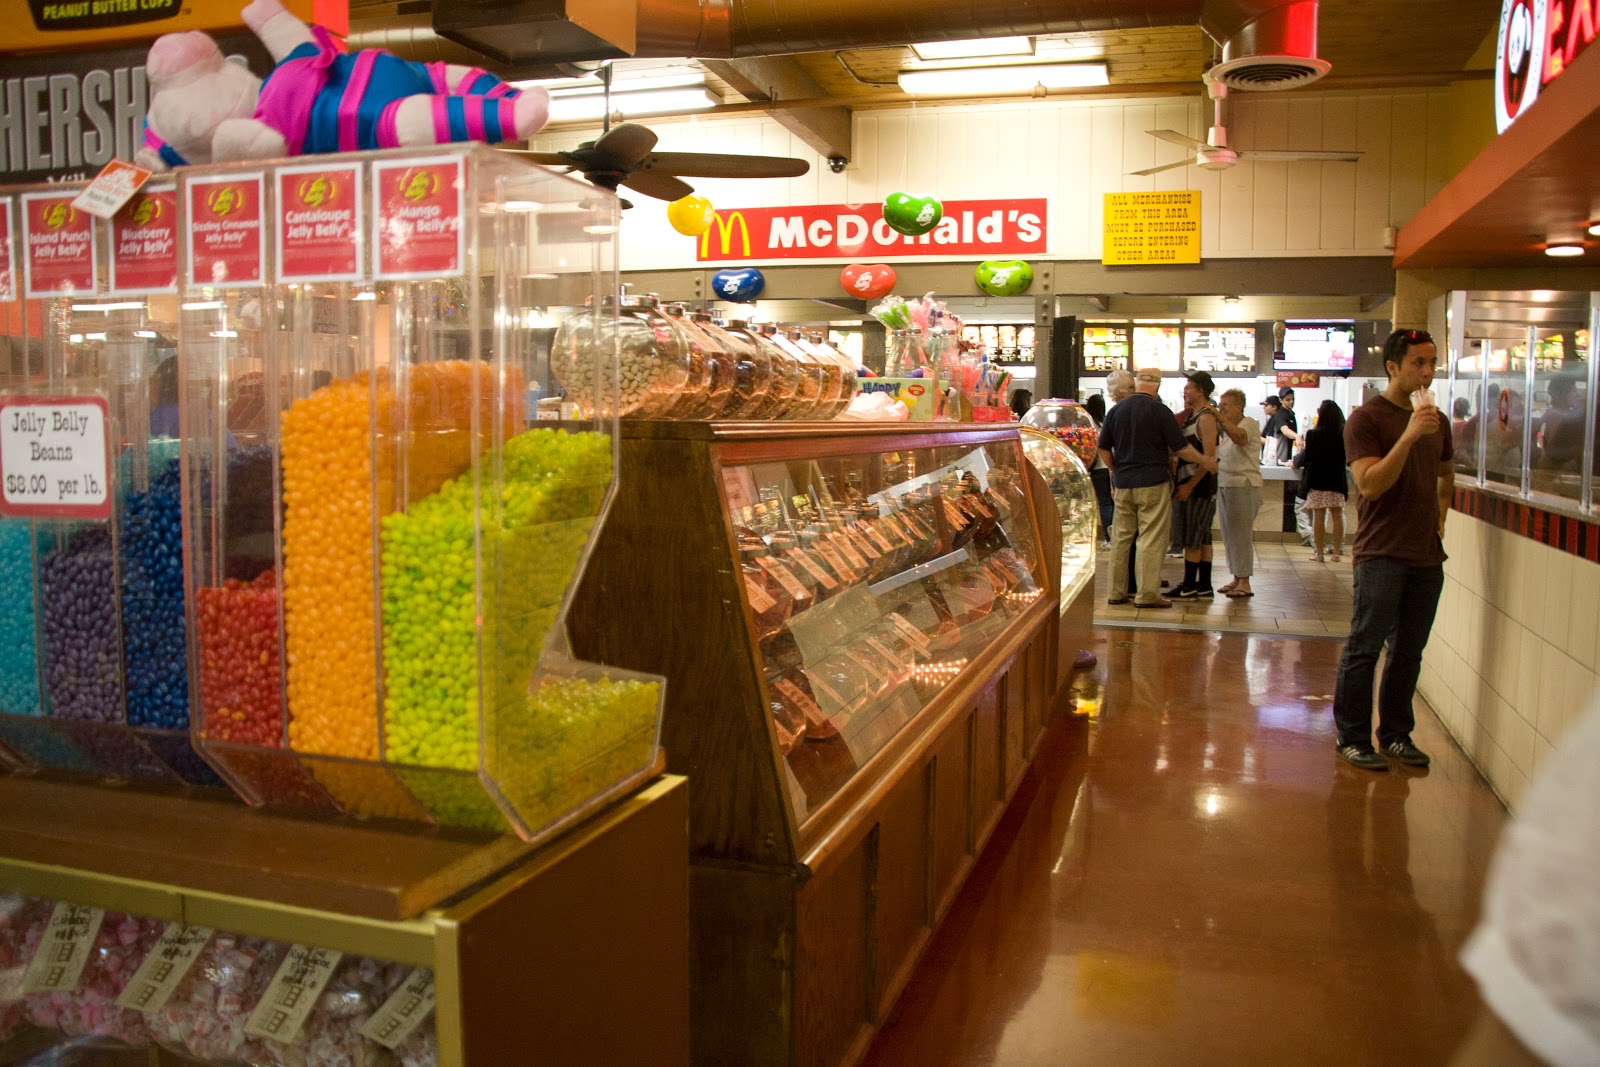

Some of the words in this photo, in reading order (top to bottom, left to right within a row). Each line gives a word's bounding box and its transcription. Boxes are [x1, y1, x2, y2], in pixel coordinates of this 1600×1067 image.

[43, 2, 90, 20] PEANUT
[92, 0, 139, 15] BUTTER
[1542, 0, 1600, 85] EX
[0, 65, 155, 174] HERSH
[1112, 196, 1128, 206] ALL
[1132, 193, 1192, 205] MERCHANDISE
[285, 208, 350, 224] Cantaloupe
[399, 205, 440, 218] Mango
[1114, 209, 1137, 219] FROM
[1142, 208, 1160, 218] THIS
[1165, 207, 1188, 218] AREA
[287, 223, 313, 239] Jelly
[1106, 222, 1129, 233] MUST
[1134, 222, 1143, 232] BE
[1148, 221, 1196, 232] PURCHASED
[30, 232, 58, 244] Island
[60, 229, 90, 242] Punch
[122, 228, 170, 242] Blueberry
[1113, 236, 1144, 247] BEFORE
[1148, 235, 1188, 246] ENTERING
[34, 246, 56, 258] Jelly
[119, 243, 143, 255] Jelly
[1116, 250, 1143, 260] OTHER
[1148, 249, 1175, 260] AREAS
[863, 382, 901, 397] HAPPY
[12, 411, 46, 437] Jelly
[52, 411, 88, 436] Belly
[30, 441, 73, 461] Beans
[7, 474, 47, 494] $8.00
[58, 480, 79, 500] per
[84, 474, 102, 494] lb.
